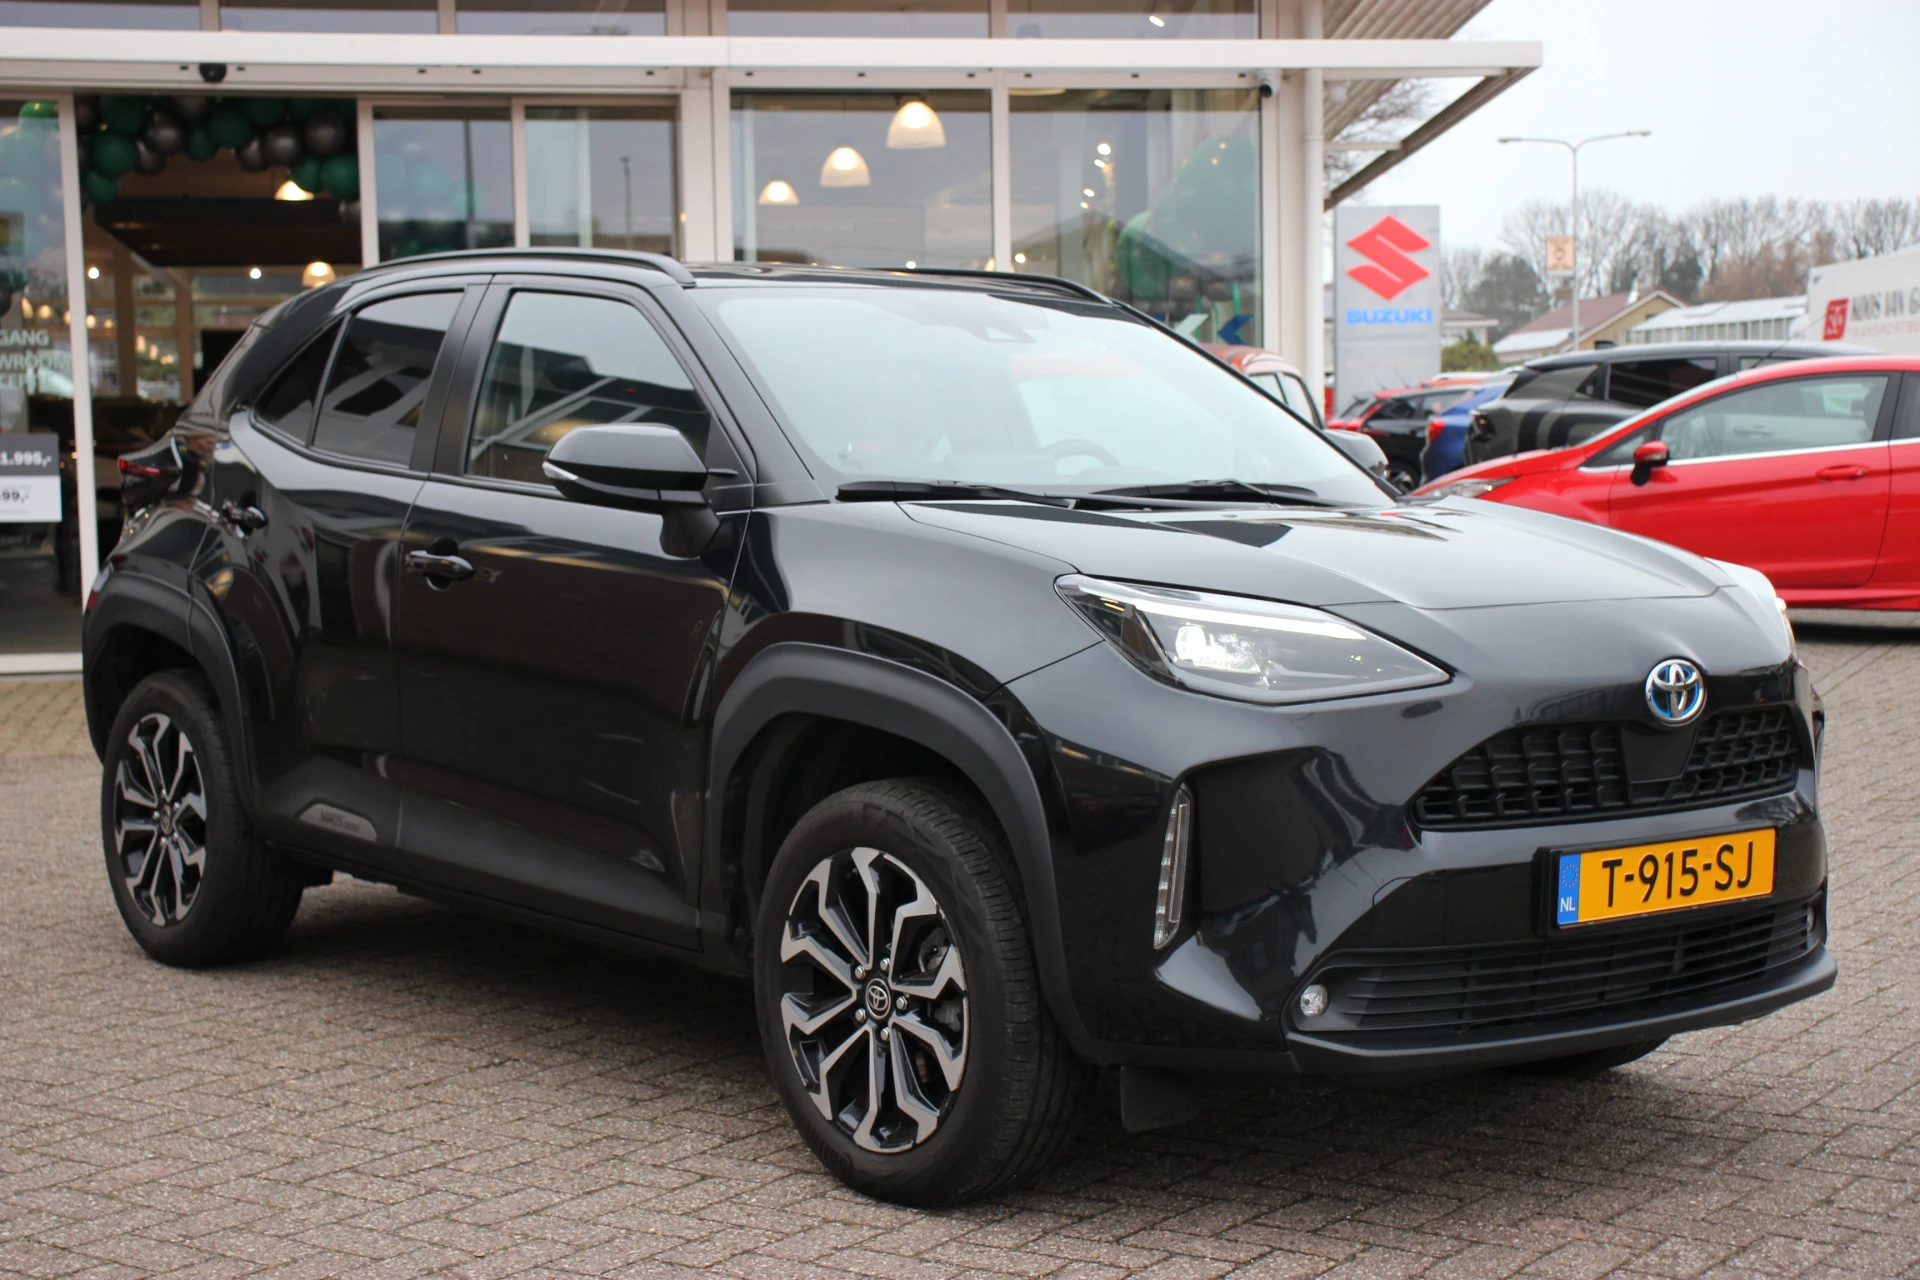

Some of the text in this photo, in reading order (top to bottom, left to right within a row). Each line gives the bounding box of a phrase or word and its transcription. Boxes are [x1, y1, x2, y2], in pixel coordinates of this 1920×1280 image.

[1345, 308, 1433, 325] SUZUKI
[1601, 841, 1754, 907] T-915-SJ
[1560, 896, 1576, 912] NL
